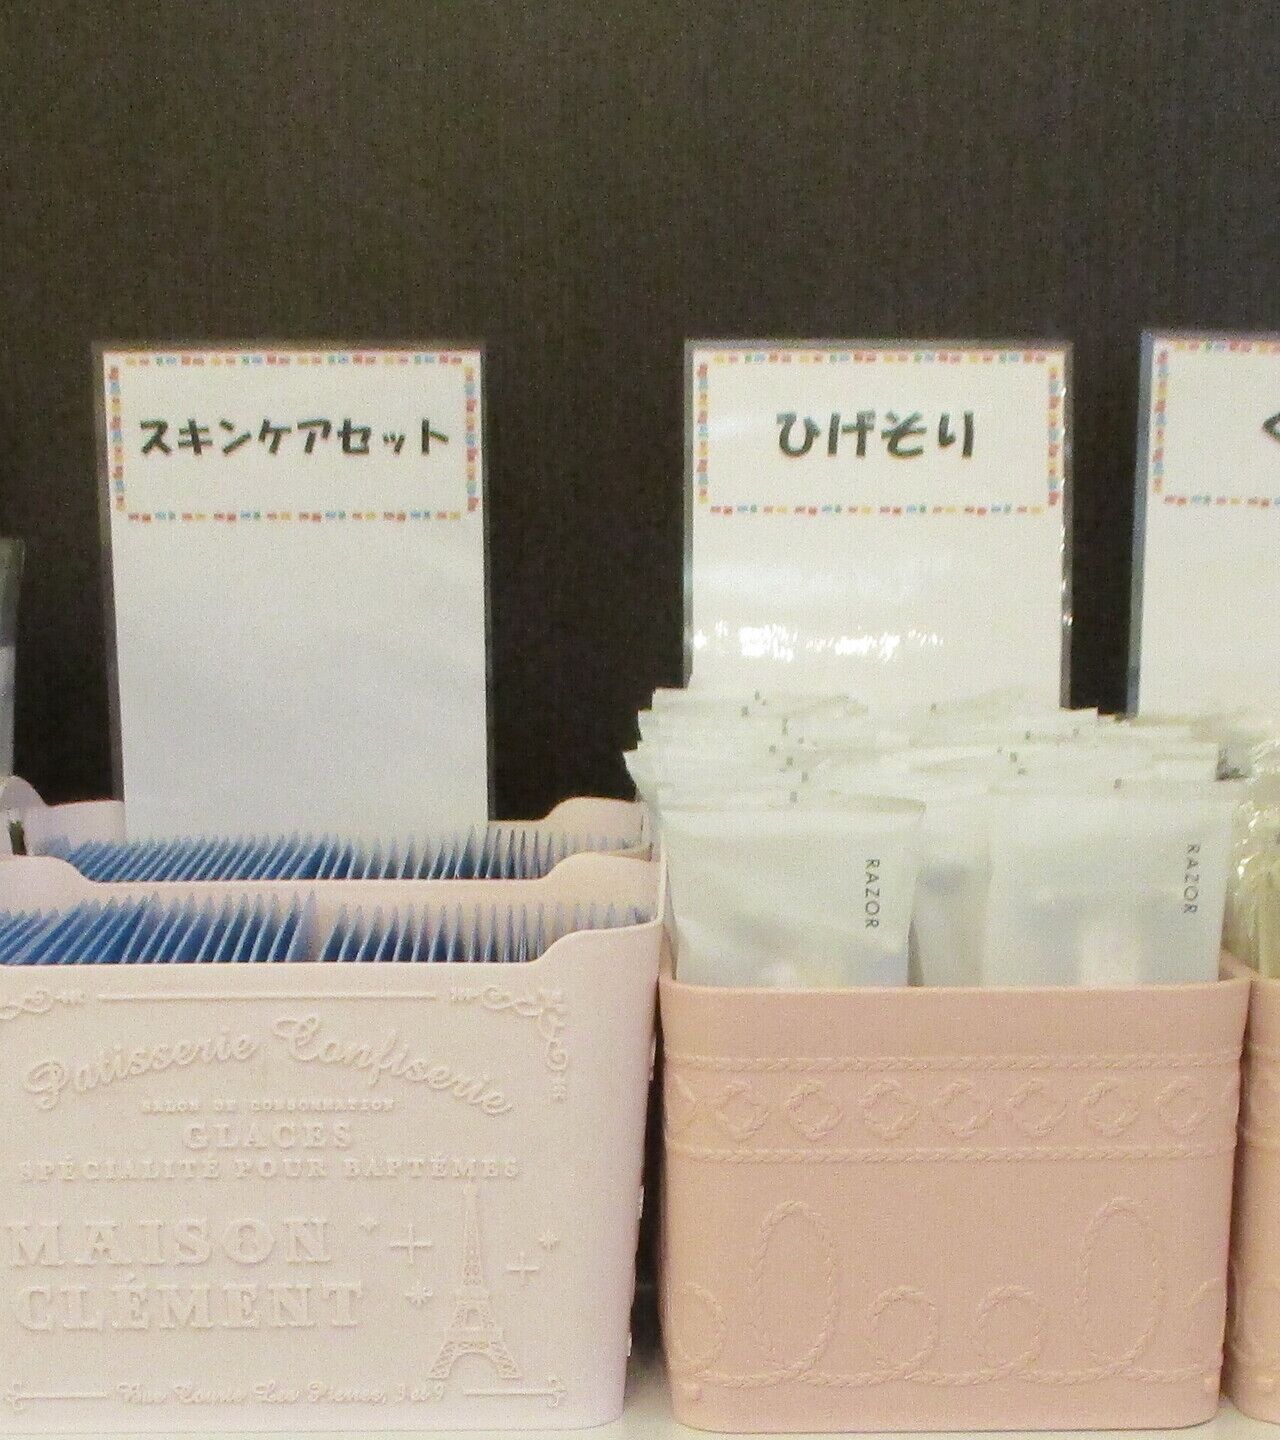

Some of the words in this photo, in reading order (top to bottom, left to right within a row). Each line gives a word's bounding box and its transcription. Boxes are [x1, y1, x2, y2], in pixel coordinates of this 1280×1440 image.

[138, 415, 450, 454] スキンケアセット
[774, 409, 976, 459] ひげそり
[864, 858, 881, 930] RAZOR
[1181, 843, 1201, 915] RAZOR
[22, 1027, 260, 1112] Patisserie
[272, 1012, 515, 1116] Confiserie
[183, 1120, 356, 1151] GLACES
[18, 1154, 220, 1182] SPÉCIALITÉ
[233, 1156, 327, 1179] POUR
[5, 1216, 332, 1269] MAISON
[13, 1273, 363, 1333] CLÉMENT
